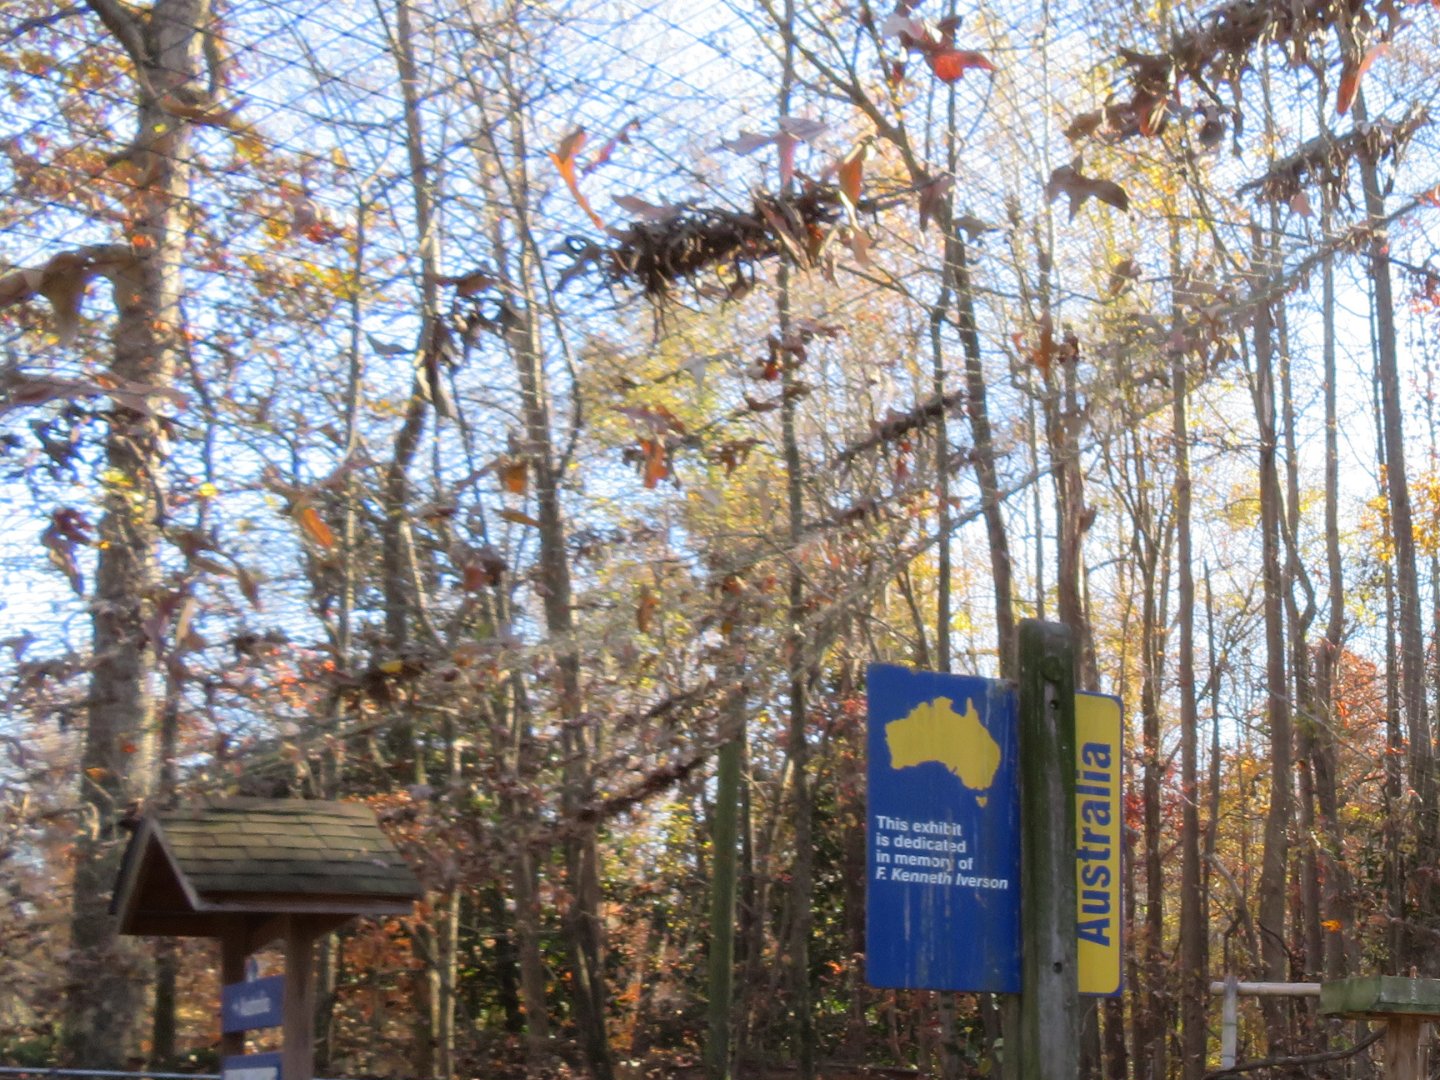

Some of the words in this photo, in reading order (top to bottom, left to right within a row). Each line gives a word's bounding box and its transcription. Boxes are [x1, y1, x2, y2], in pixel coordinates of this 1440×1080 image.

[876, 815, 909, 831] This
[912, 821, 962, 836] exhibit
[876, 832, 890, 847] is
[893, 834, 967, 853] dedicated
[1076, 742, 1112, 947] Australia
[876, 849, 890, 863] in
[894, 853, 955, 872] memory
[958, 857, 974, 870] of
[875, 866, 887, 880] F.
[891, 867, 952, 885] Kenneth
[955, 873, 1009, 889] Iverson
